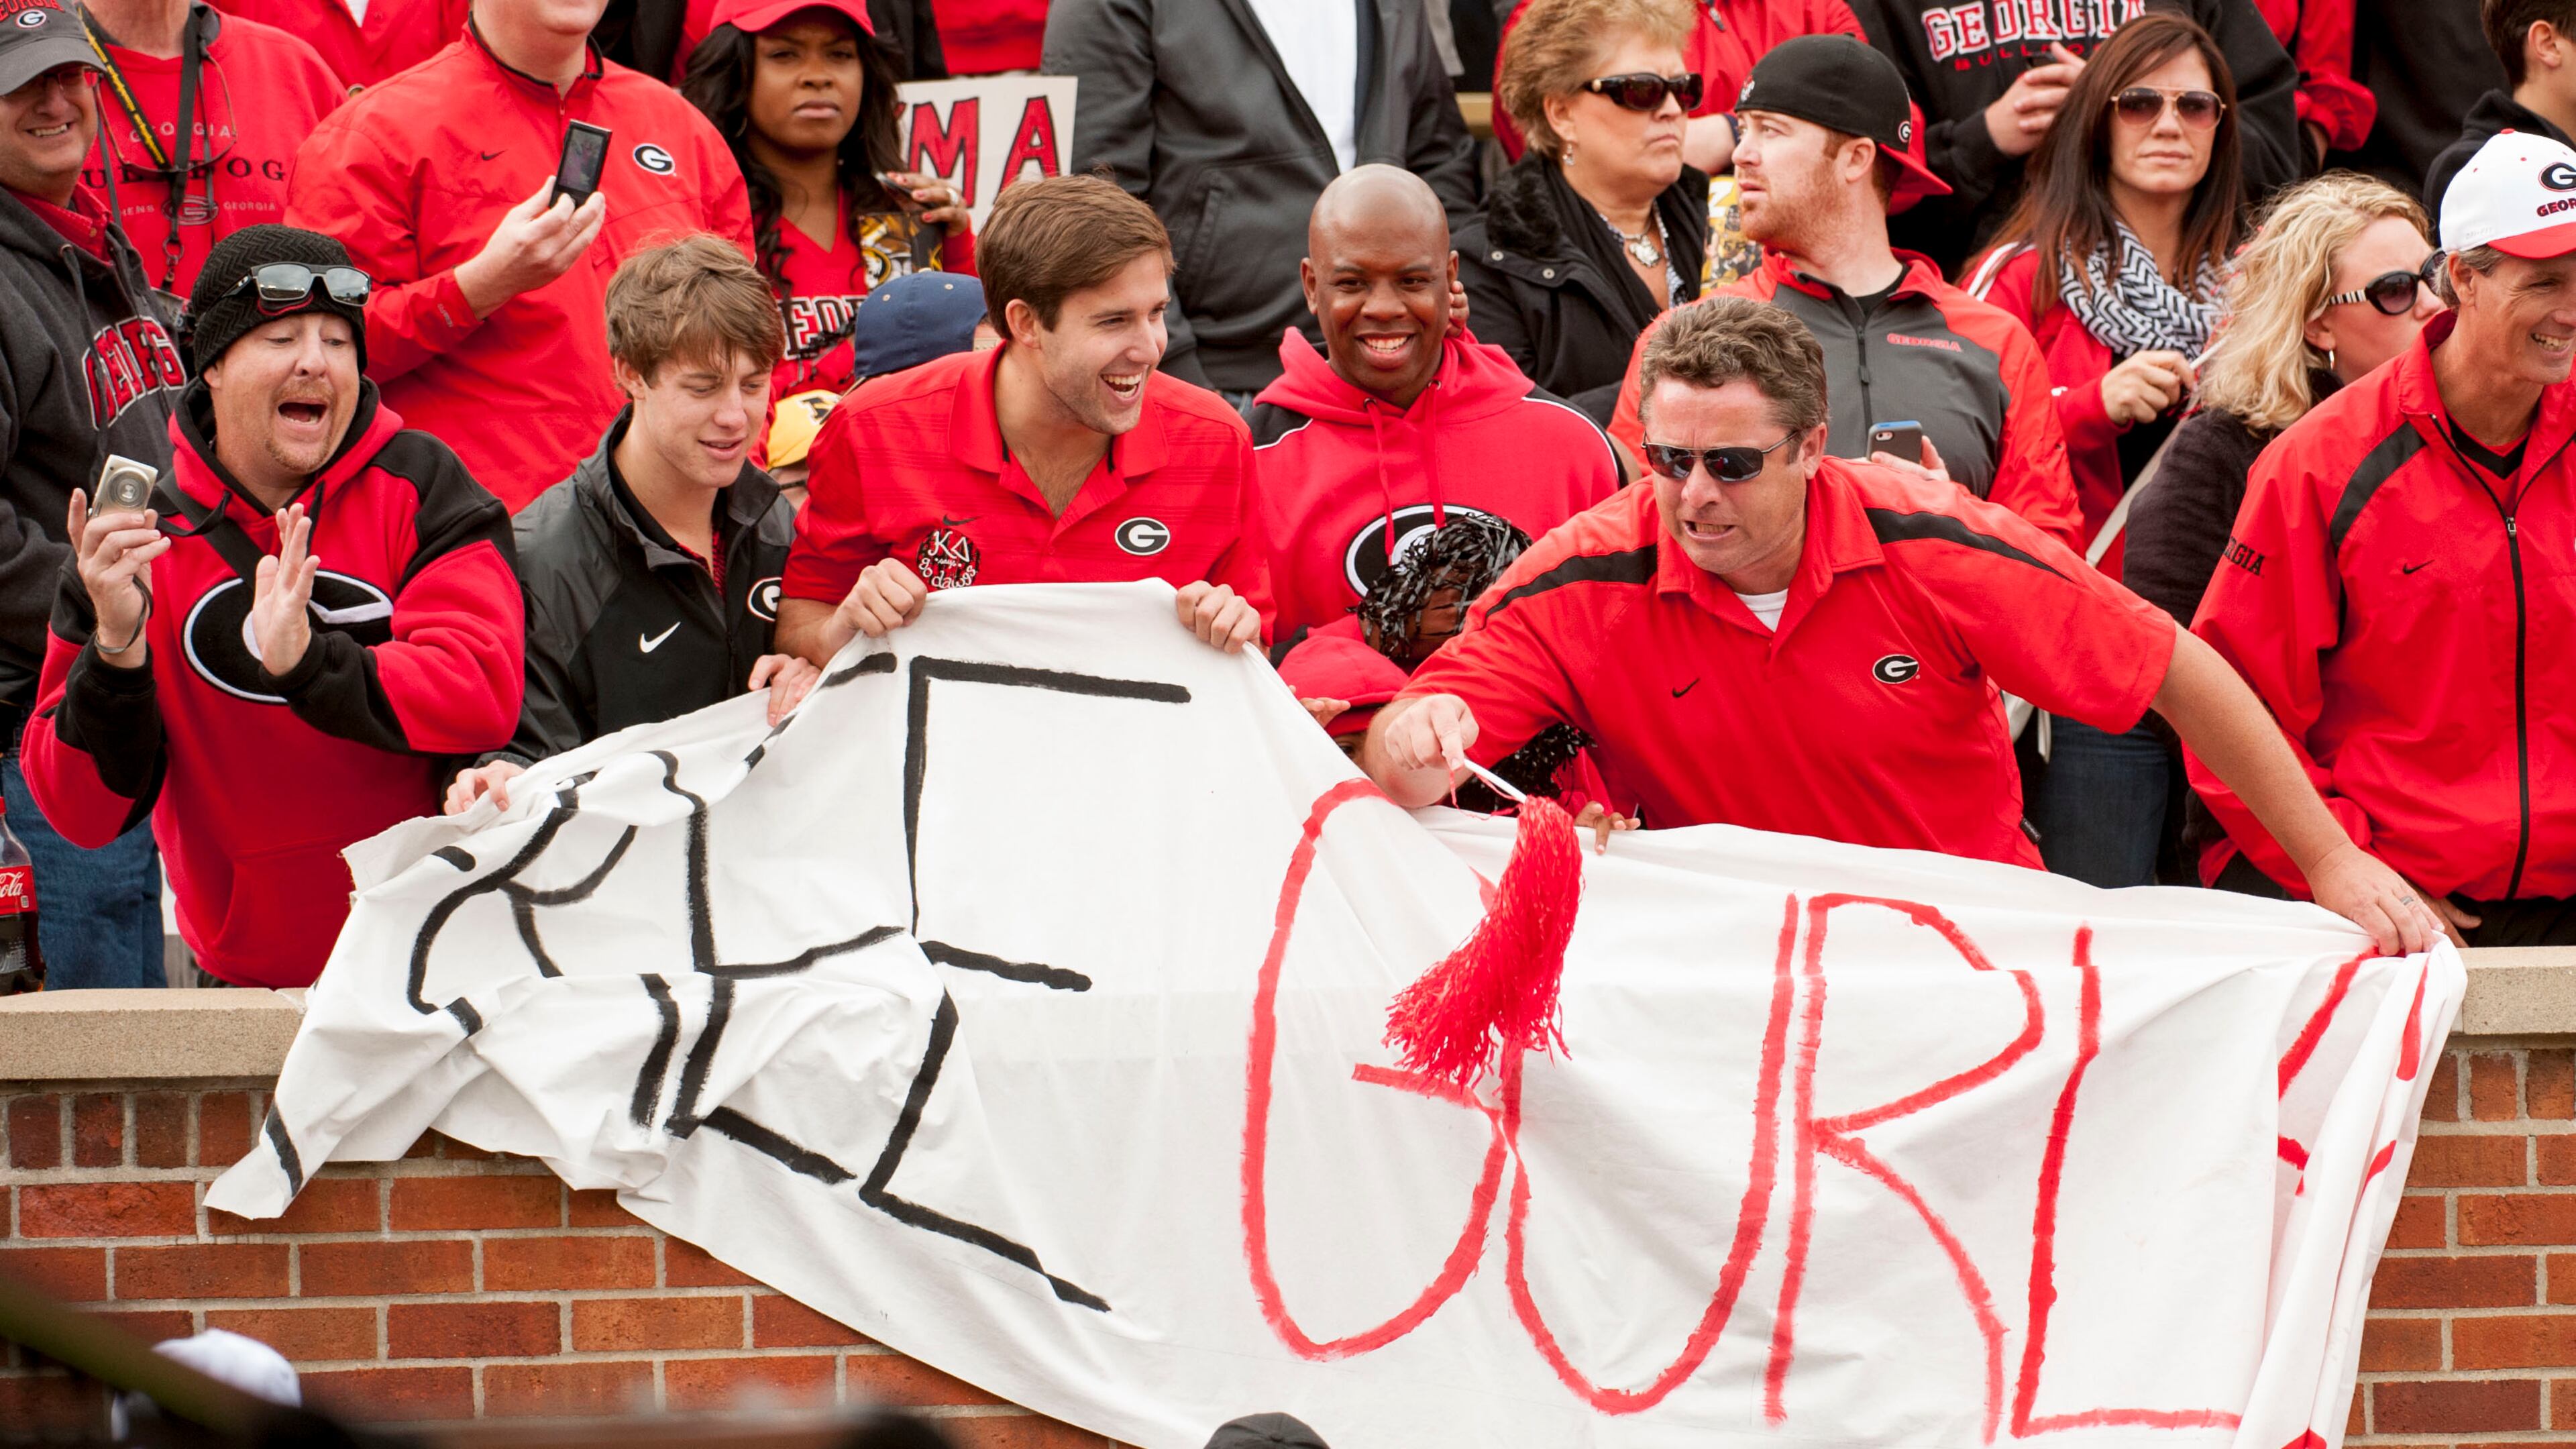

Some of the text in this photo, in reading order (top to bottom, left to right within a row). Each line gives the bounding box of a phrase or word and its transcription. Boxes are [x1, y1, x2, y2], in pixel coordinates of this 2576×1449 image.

[633, 142, 676, 176] G
[894, 95, 1061, 209] MA
[1114, 517, 1171, 559] G
[1872, 653, 1920, 684] G
[0, 871, 25, 899] ola
